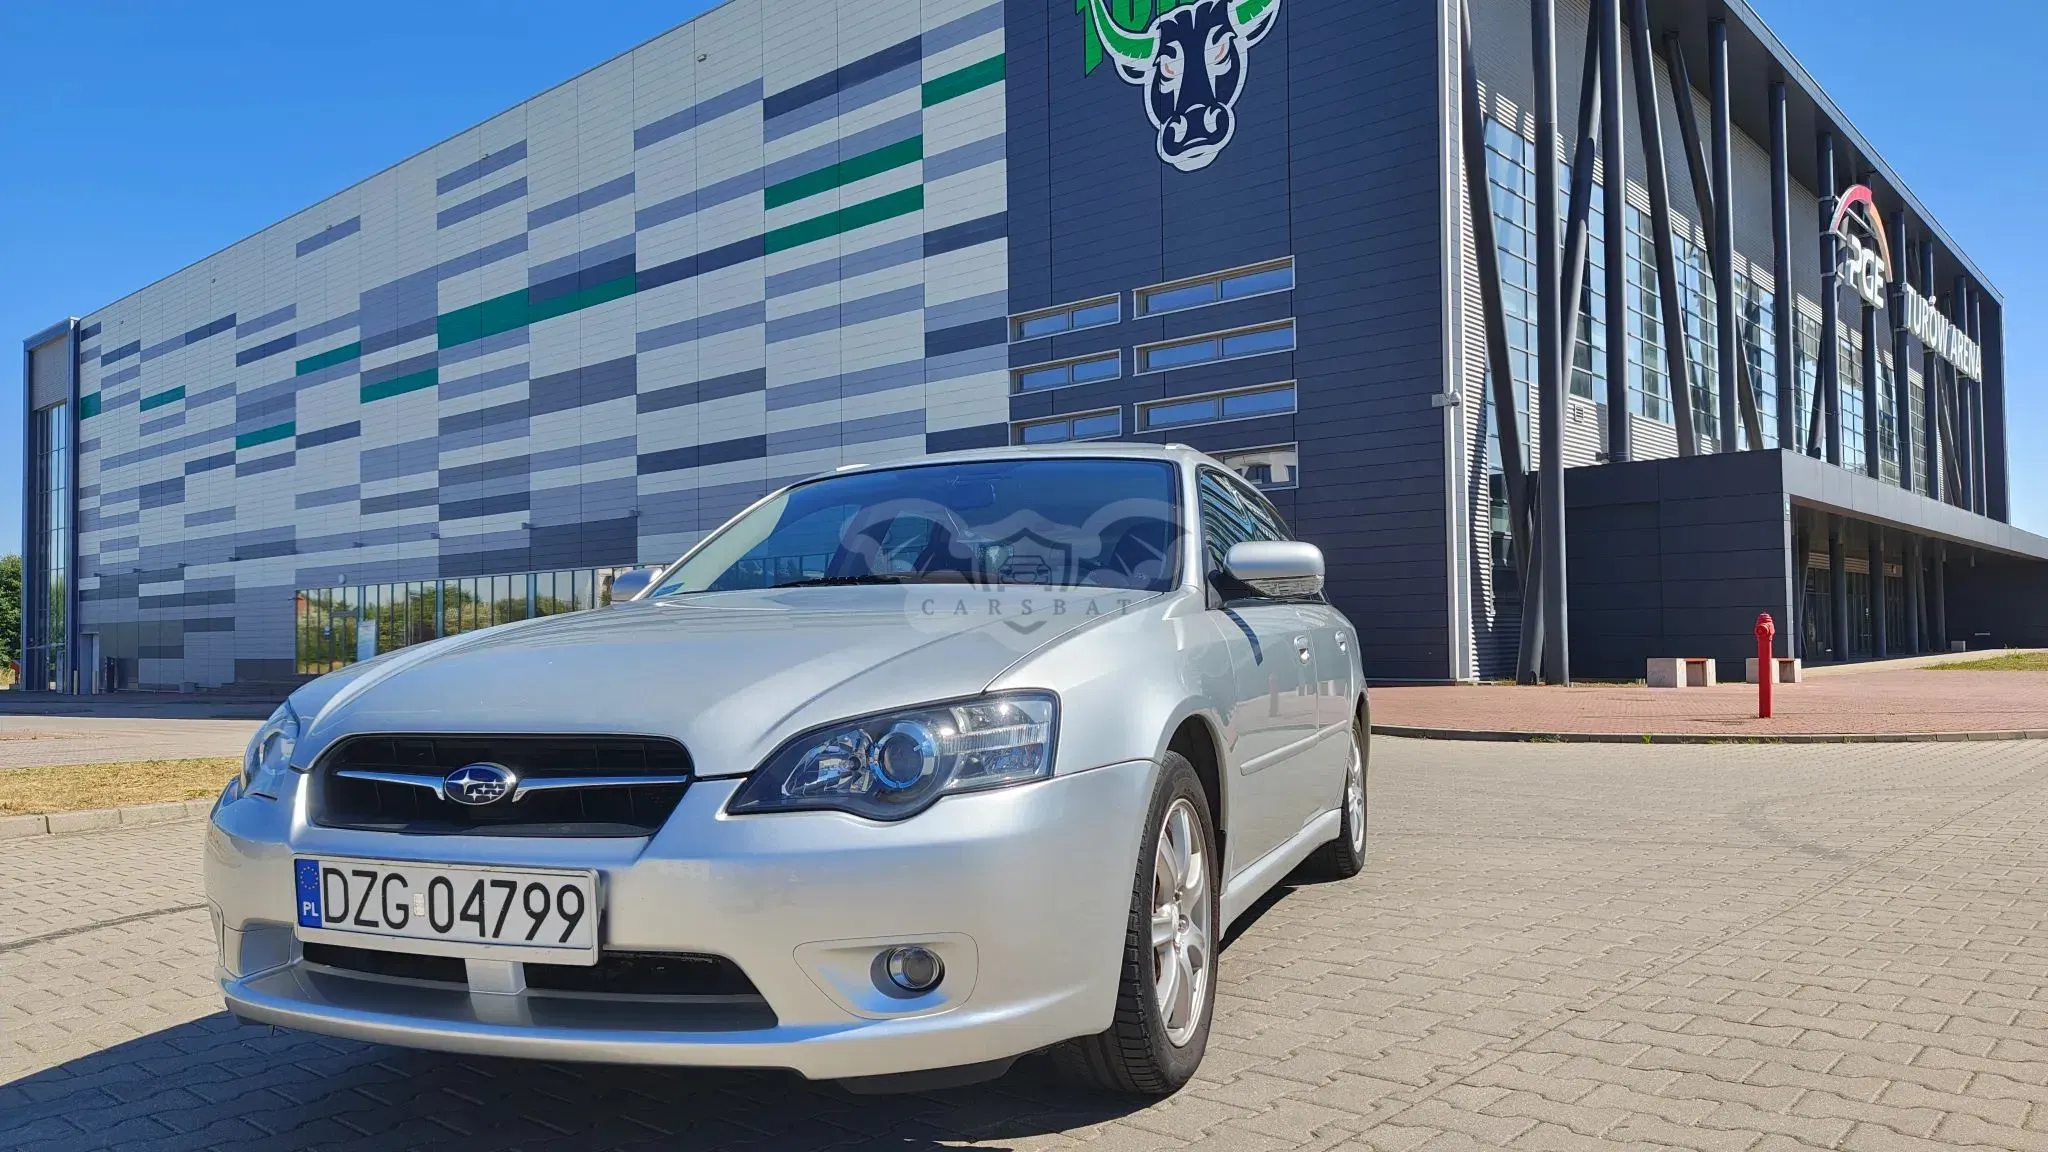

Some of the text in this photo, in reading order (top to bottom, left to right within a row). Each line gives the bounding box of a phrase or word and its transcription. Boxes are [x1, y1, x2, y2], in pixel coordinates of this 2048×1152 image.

[1845, 234, 1885, 309] PGE
[1903, 283, 1982, 382] TURÓW ARENA
[302, 901, 320, 917] PL
[322, 867, 585, 943] DZG 04799
